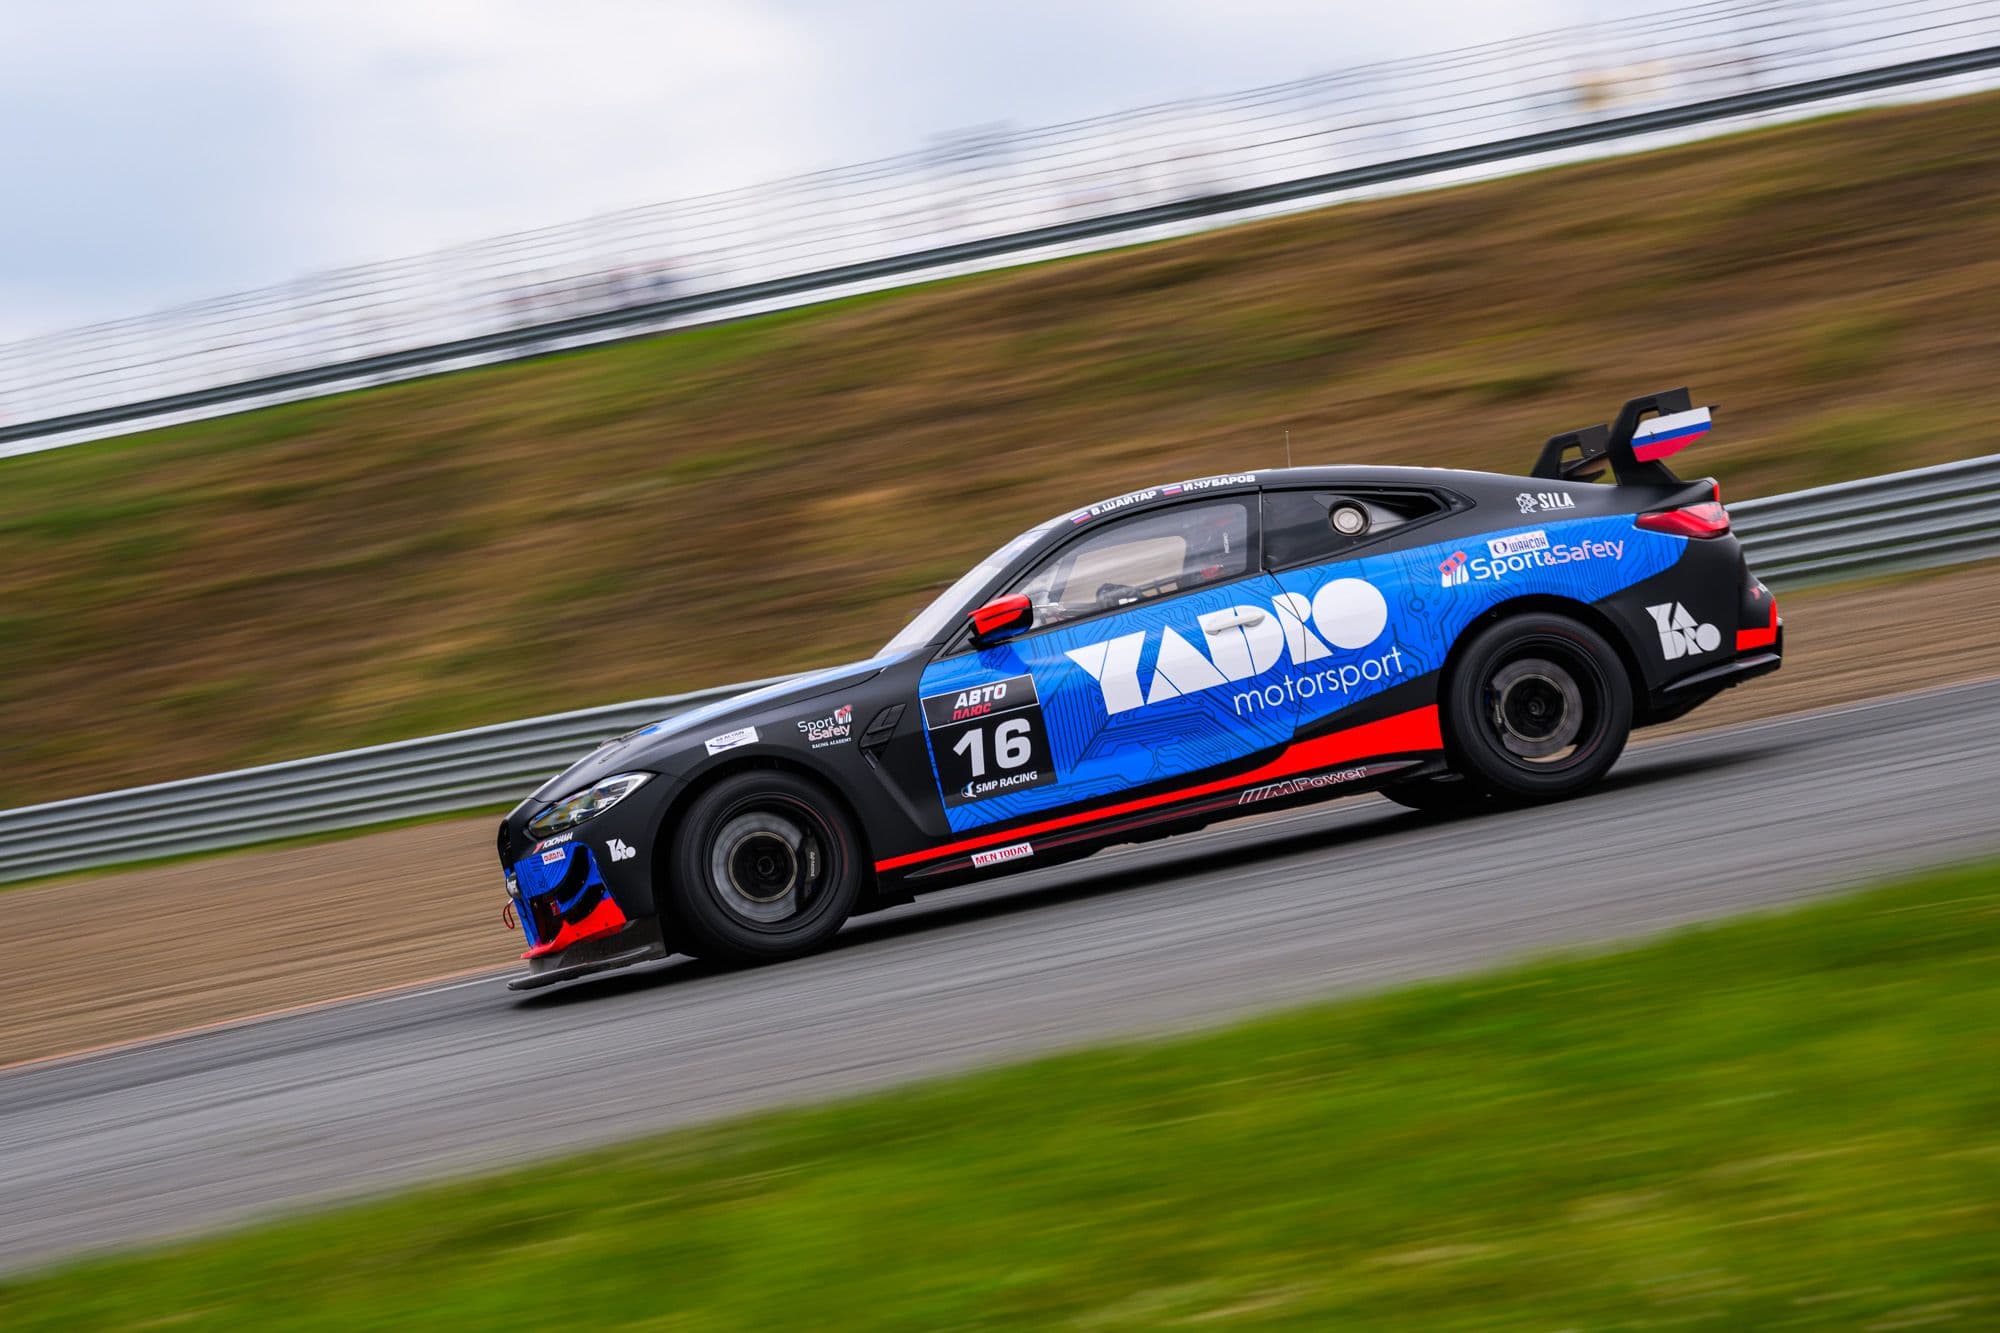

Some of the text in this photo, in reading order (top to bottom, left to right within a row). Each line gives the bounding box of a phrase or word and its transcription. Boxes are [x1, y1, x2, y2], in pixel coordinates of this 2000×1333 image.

[1183, 474, 1256, 491] И.ЧУБАРОВ
[1090, 490, 1157, 517] В.ШАЙТАР
[1537, 492, 1575, 509] SILA
[1470, 540, 1624, 580] Sport&Safety
[1064, 577, 1388, 716] YADRO
[1233, 646, 1403, 716] motorsport
[954, 683, 1007, 710] АВТО
[952, 702, 992, 721] ПЛЮС
[797, 716, 835, 734] Sport
[953, 718, 1032, 777] 16
[976, 771, 1038, 793] SMP RACING
[975, 844, 1029, 865] MEN TODAY
